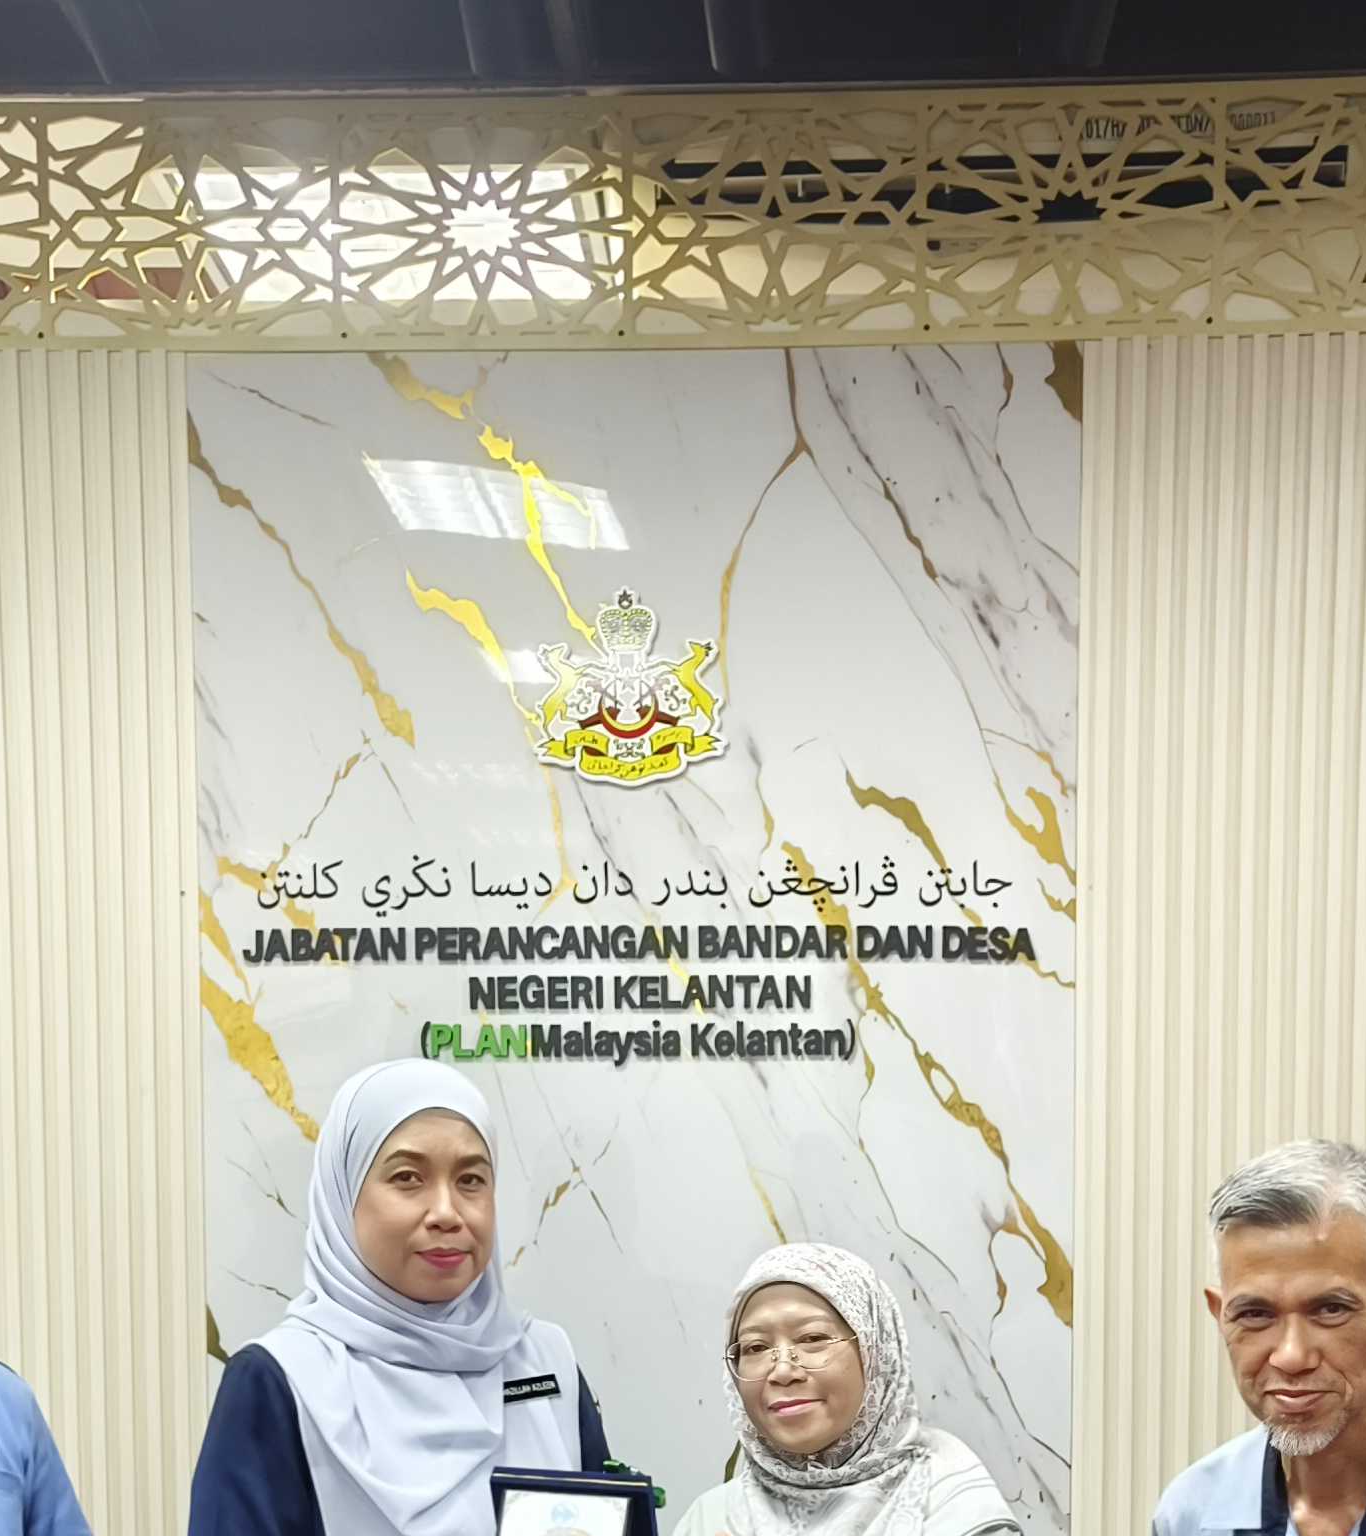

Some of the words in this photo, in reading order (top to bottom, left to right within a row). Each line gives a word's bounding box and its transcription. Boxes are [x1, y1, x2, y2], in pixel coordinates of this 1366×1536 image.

[469, 861, 553, 910] ديسا
[572, 861, 635, 904] دان
[651, 868, 729, 910] بندر
[918, 859, 1014, 911] جابتن
[242, 926, 407, 963] JABATAN
[415, 925, 689, 962] PERANCANGAN
[697, 924, 849, 961] BANDAR
[856, 924, 934, 961] DAN
[941, 925, 1037, 962] DESA
[468, 974, 604, 1011] NEGERI
[613, 974, 812, 1011] KELANTAN
[689, 1018, 856, 1061] Kelantan)
